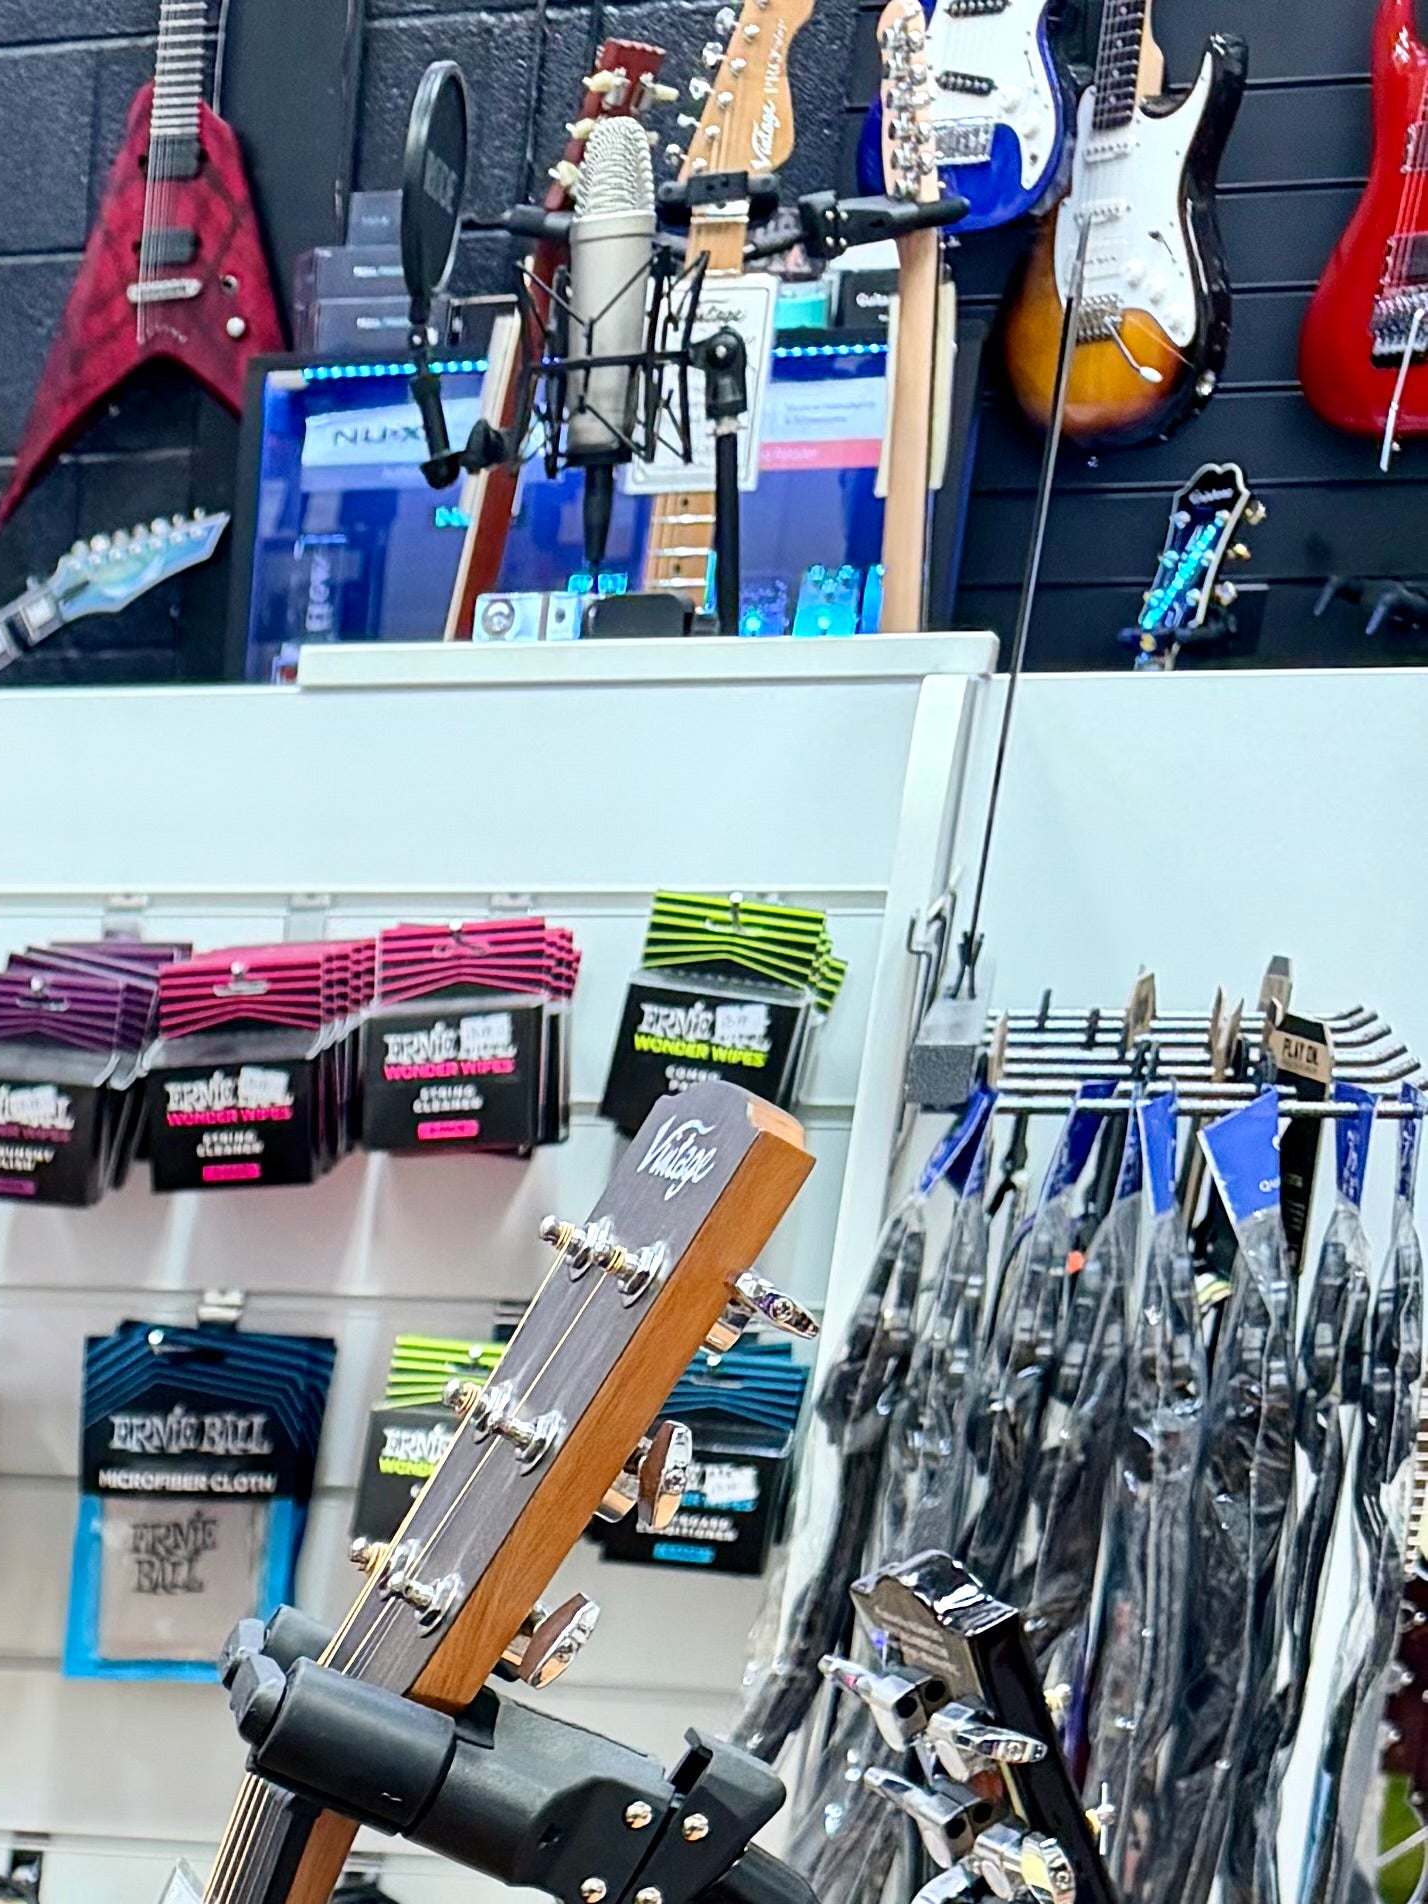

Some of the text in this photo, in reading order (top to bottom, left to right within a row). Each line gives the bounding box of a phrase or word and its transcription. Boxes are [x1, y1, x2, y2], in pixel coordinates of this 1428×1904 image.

[637, 1000, 715, 1041] ERNIE
[383, 1020, 460, 1064] ERNIE
[634, 1032, 769, 1068] WONDER WIPES
[383, 1058, 517, 1081] WONDER WIPES
[166, 1108, 238, 1128] WONDER
[637, 1115, 717, 1202] Vintage
[108, 1401, 274, 1455] ERNIE BALL
[98, 1467, 278, 1494] MICROFIBER CLOTH
[132, 1509, 218, 1562] ERNIE
[134, 1558, 204, 1596] BALL
